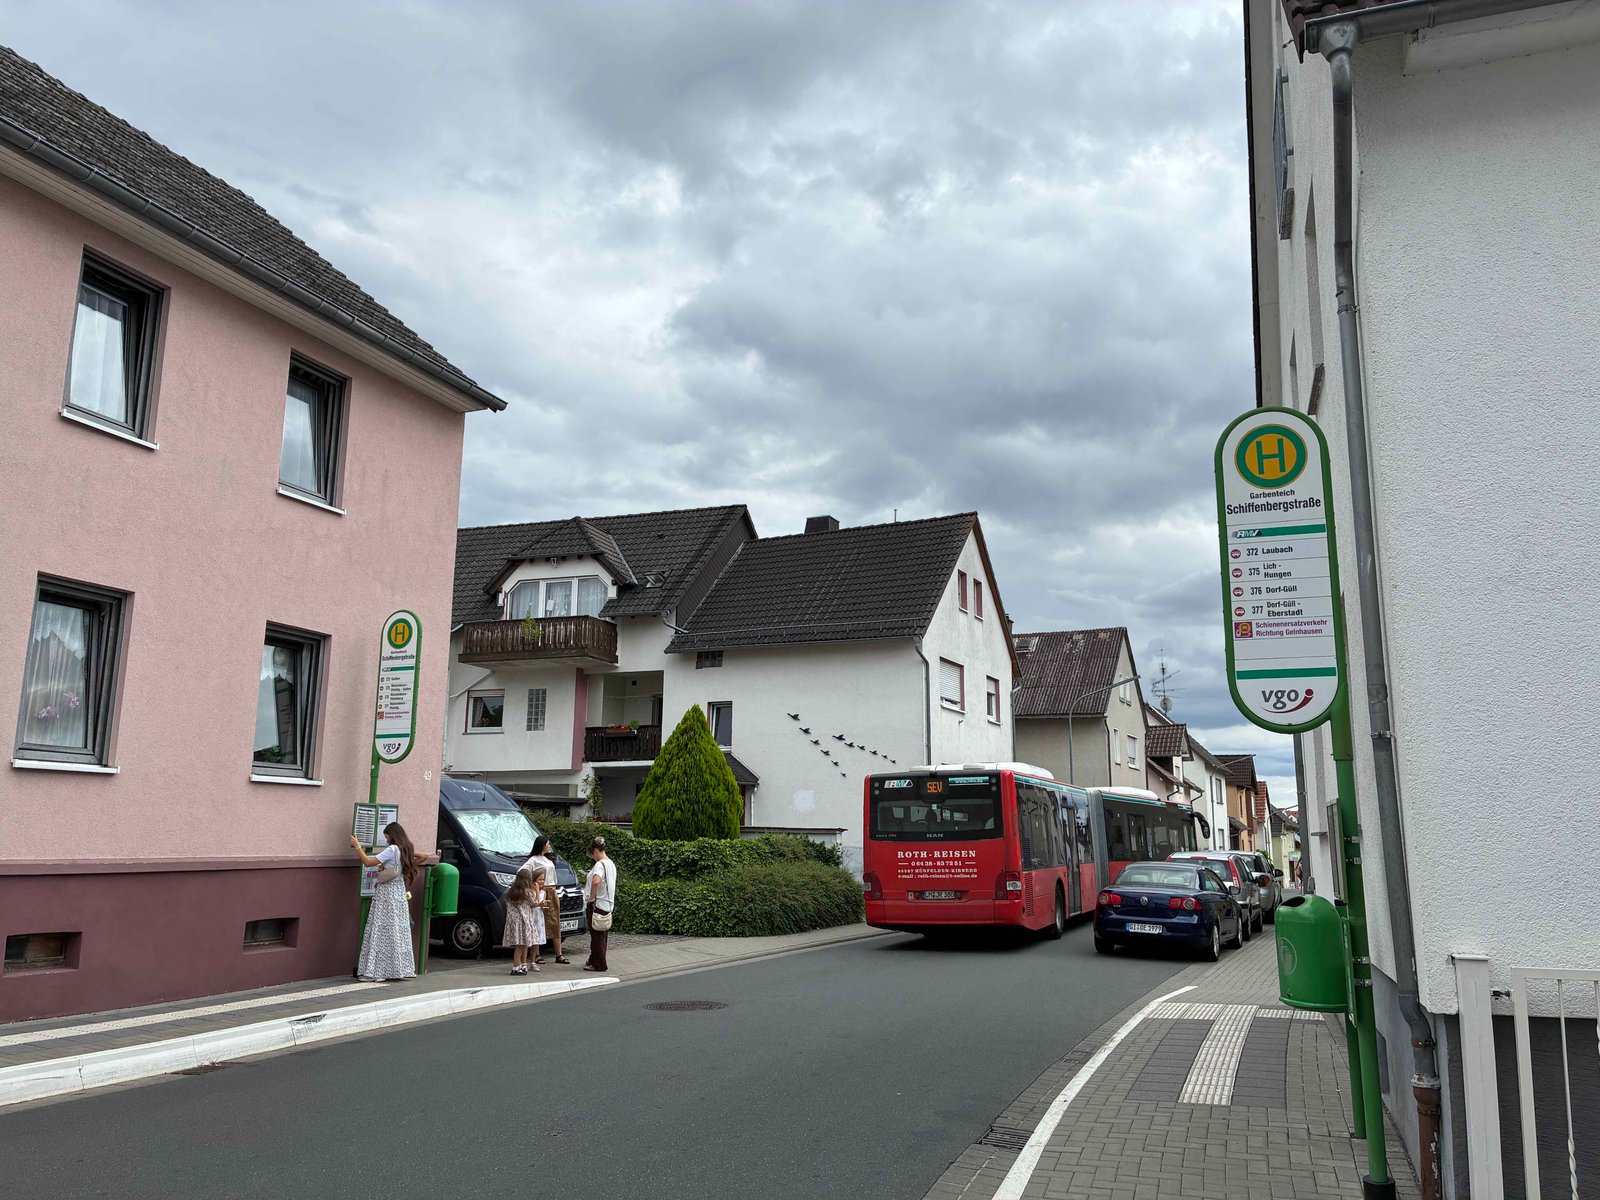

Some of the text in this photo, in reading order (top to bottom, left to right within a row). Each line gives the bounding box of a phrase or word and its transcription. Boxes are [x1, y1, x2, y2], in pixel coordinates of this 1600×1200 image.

[1256, 438, 1286, 475] H
[1250, 489, 1295, 499] Garbenteich
[1226, 497, 1321, 515] Schiffenbergstraße
[1246, 546, 1293, 556] 372 Laubach
[1248, 568, 1260, 576] 375
[1264, 571, 1292, 579] Hungen
[1250, 585, 1297, 595] 376 Dorf-Güll
[1266, 600, 1296, 609] Dorf-Güll
[1252, 606, 1264, 614] 377
[1267, 609, 1303, 617] Eberstadt
[1255, 620, 1328, 629] Schienenersatzverkehr
[394, 625, 405, 642] H
[1256, 628, 1323, 638] Richtung Gelnhausen
[1261, 689, 1299, 710] vgo
[382, 743, 396, 753] vgo
[423, 770, 432, 781] 49
[927, 782, 943, 793] SEV
